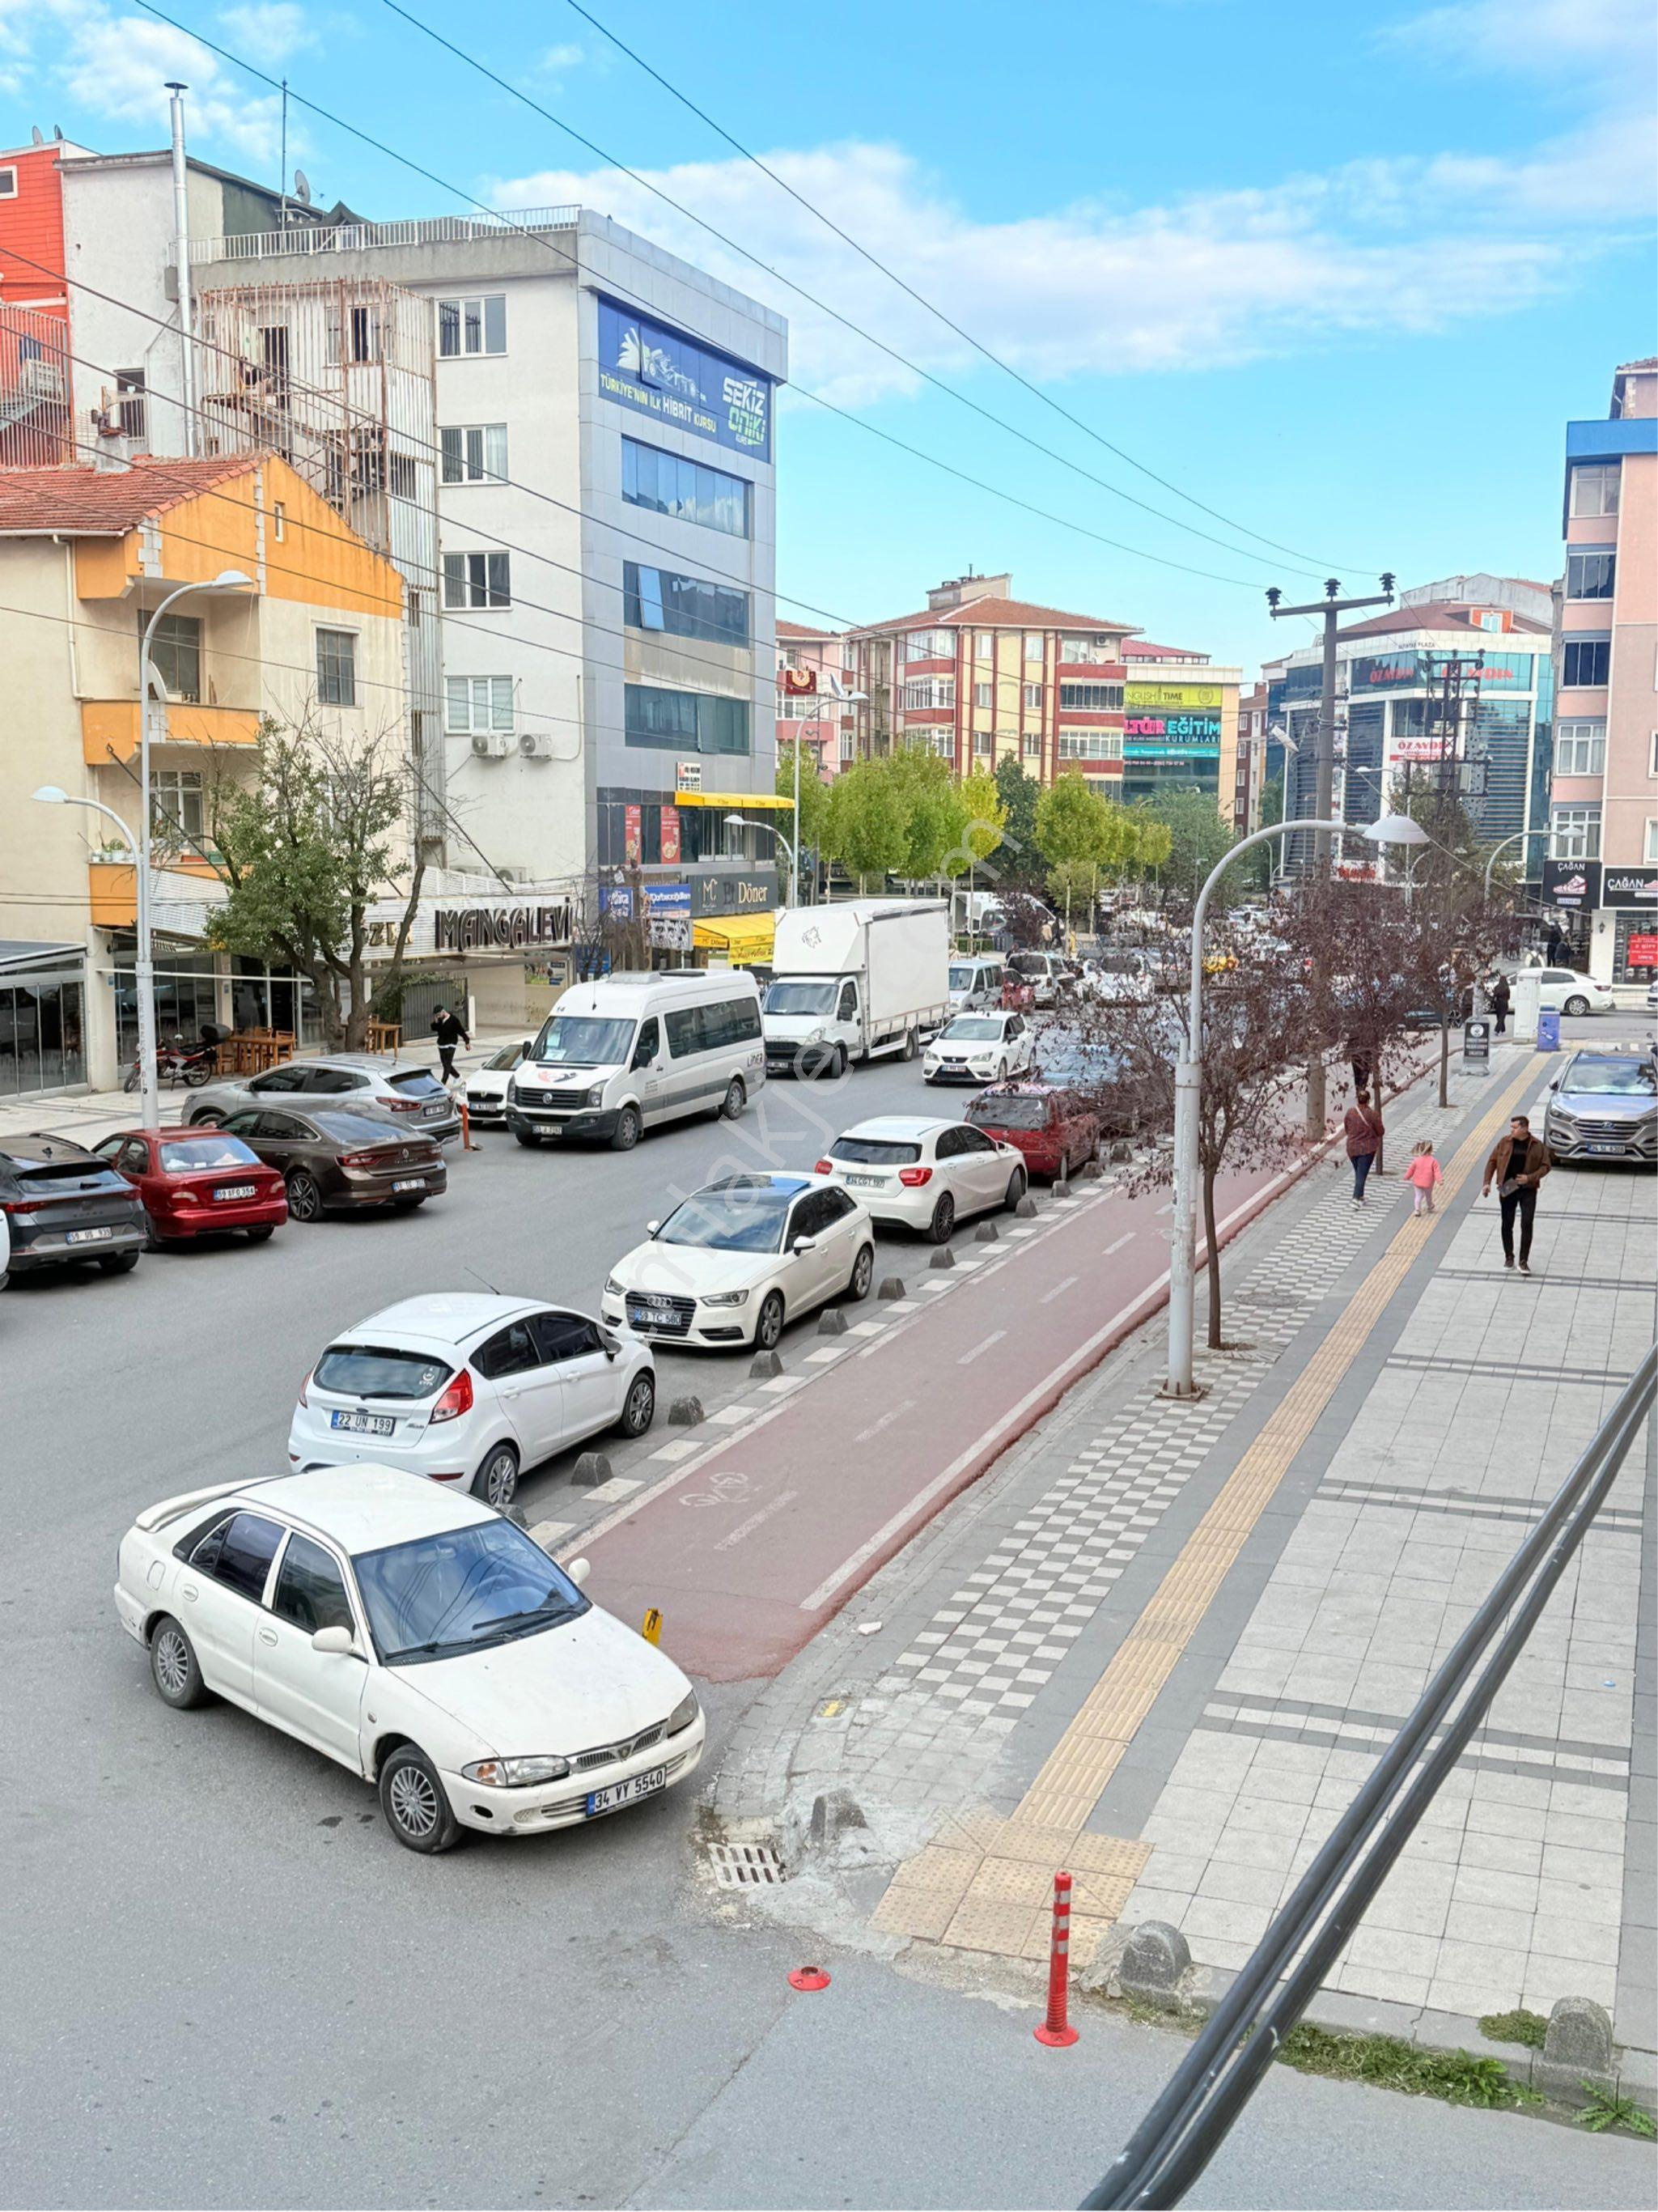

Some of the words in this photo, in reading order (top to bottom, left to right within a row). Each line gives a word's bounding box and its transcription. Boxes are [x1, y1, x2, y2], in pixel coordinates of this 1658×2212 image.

[662, 396, 693, 423] HİBRİT
[1126, 691, 1156, 701] NGLISH
[1164, 692, 1184, 701] TIME
[1124, 715, 1165, 735] LTÜR
[1168, 715, 1221, 736] EĞİTİM
[738, 881, 769, 905] Döner
[1607, 877, 1644, 891] ÇAĞAN
[339, 1413, 351, 1425] 22
[356, 1416, 368, 1429] UN
[373, 1419, 392, 1431] 199
[596, 1791, 609, 1809] 34
[616, 1783, 630, 1802] VY
[634, 1769, 663, 1794] 5540
